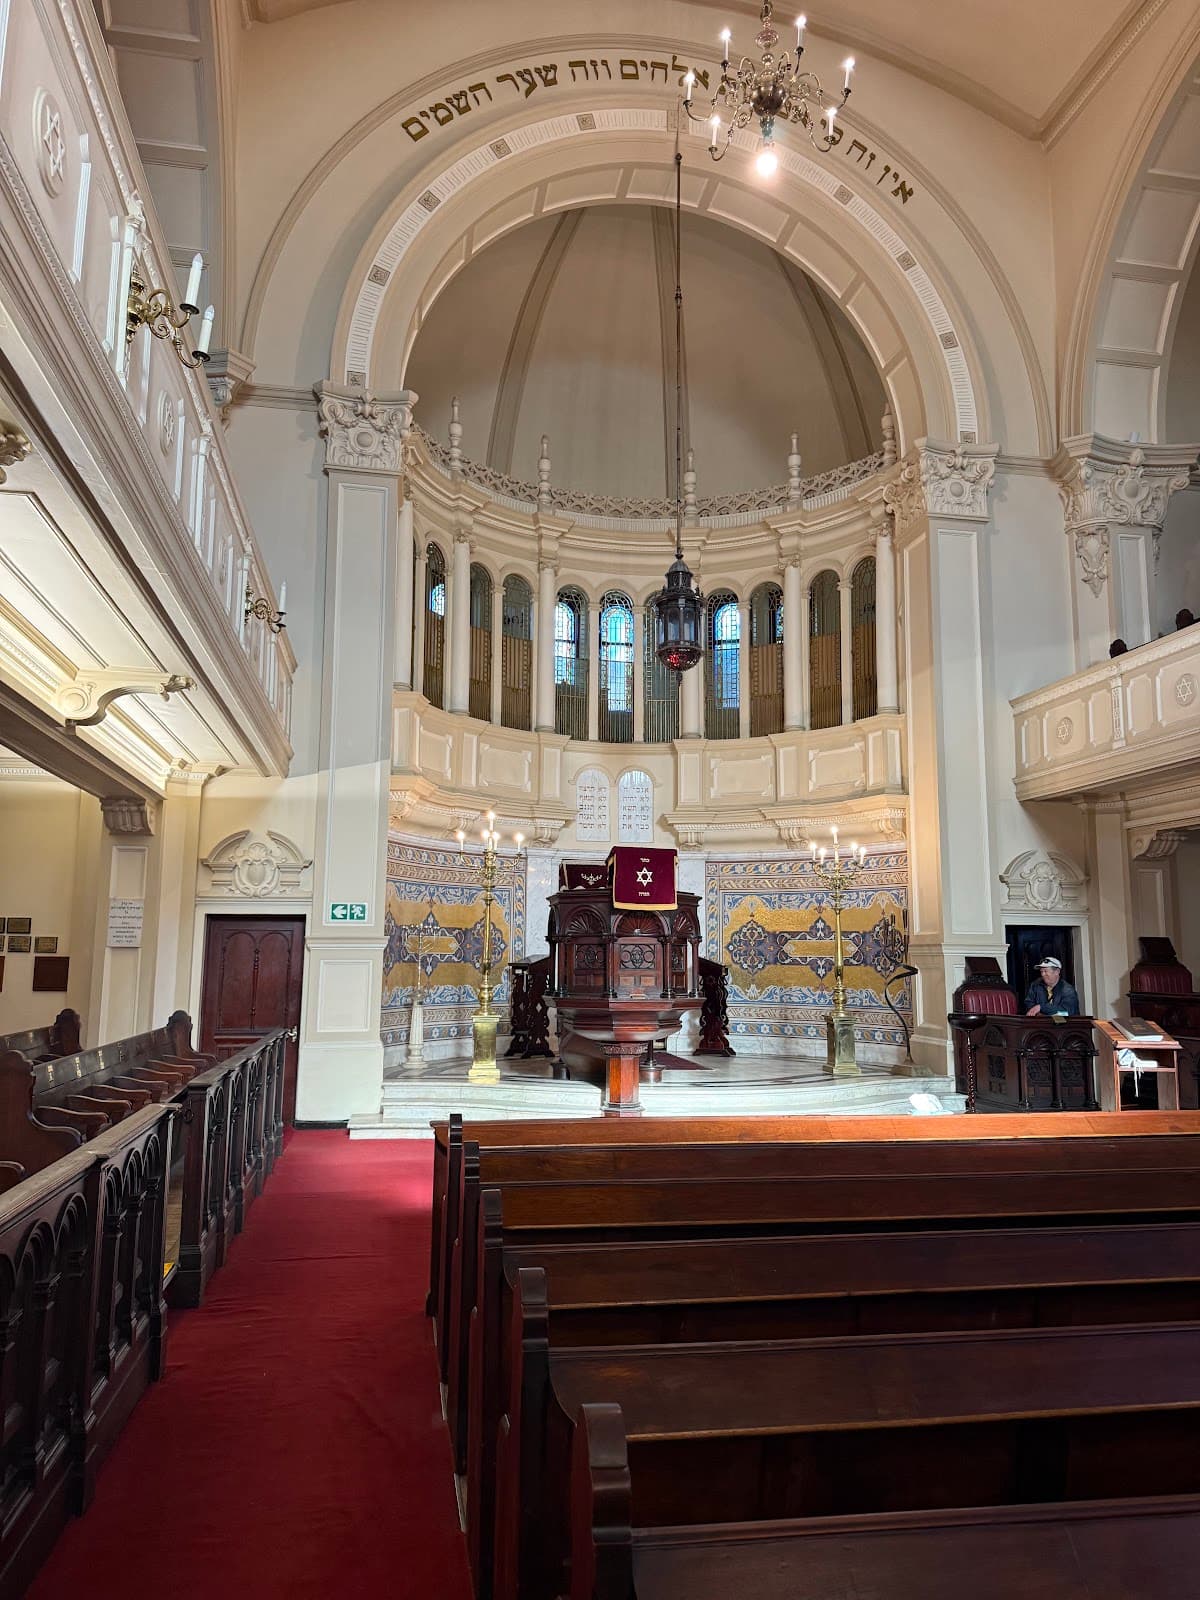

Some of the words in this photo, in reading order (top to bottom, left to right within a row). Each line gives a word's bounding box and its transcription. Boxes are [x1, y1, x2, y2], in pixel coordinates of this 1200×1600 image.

[496, 63, 558, 99] שער
[568, 59, 612, 82] וזה
[619, 55, 710, 90] אלהים
[401, 81, 493, 142] השמים
[846, 139, 876, 170] זה
[876, 164, 914, 205] אין
